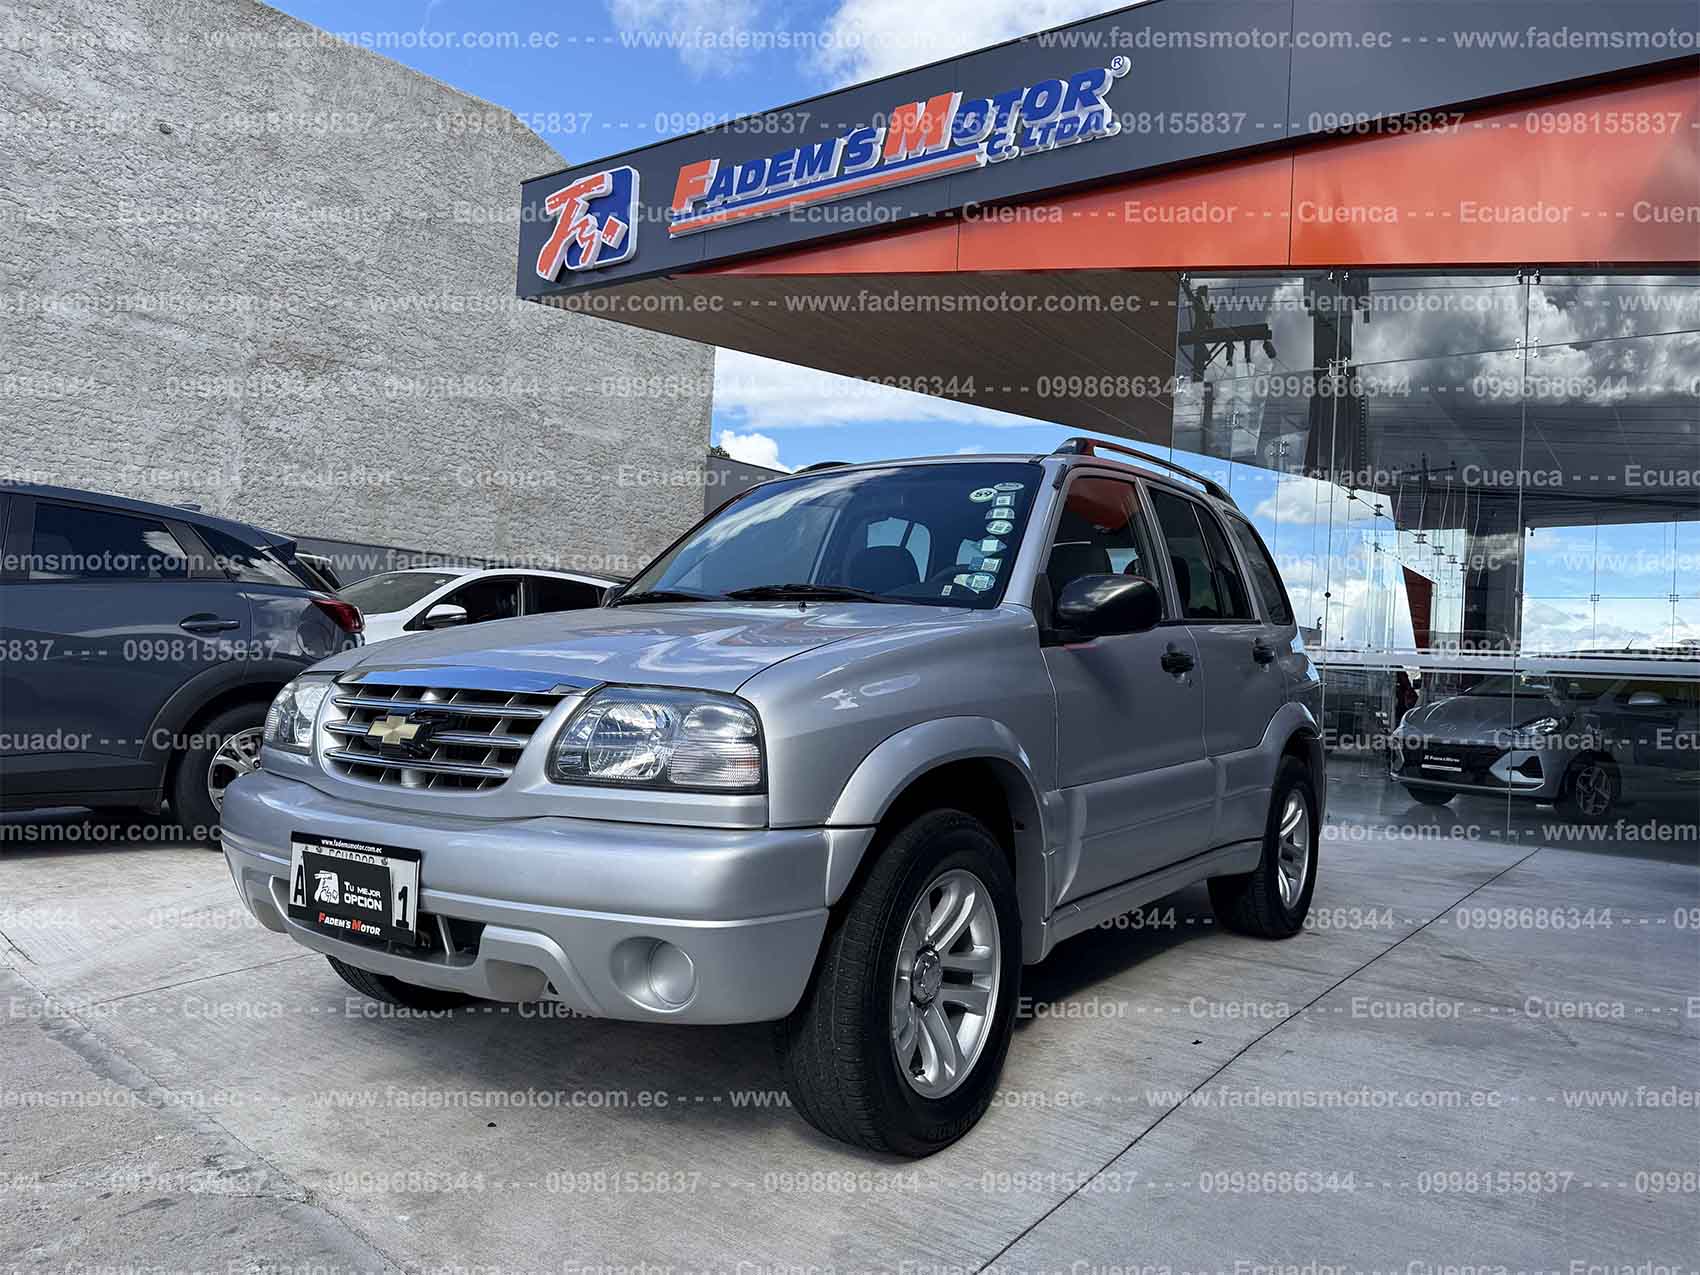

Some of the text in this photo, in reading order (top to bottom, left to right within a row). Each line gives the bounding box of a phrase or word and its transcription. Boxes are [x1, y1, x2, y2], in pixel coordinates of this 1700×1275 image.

[883, 68, 1113, 165] MOTOR
[357, 886, 382, 899] MEJOR
[396, 886, 410, 929] 1
[352, 919, 382, 936] MOTOR
